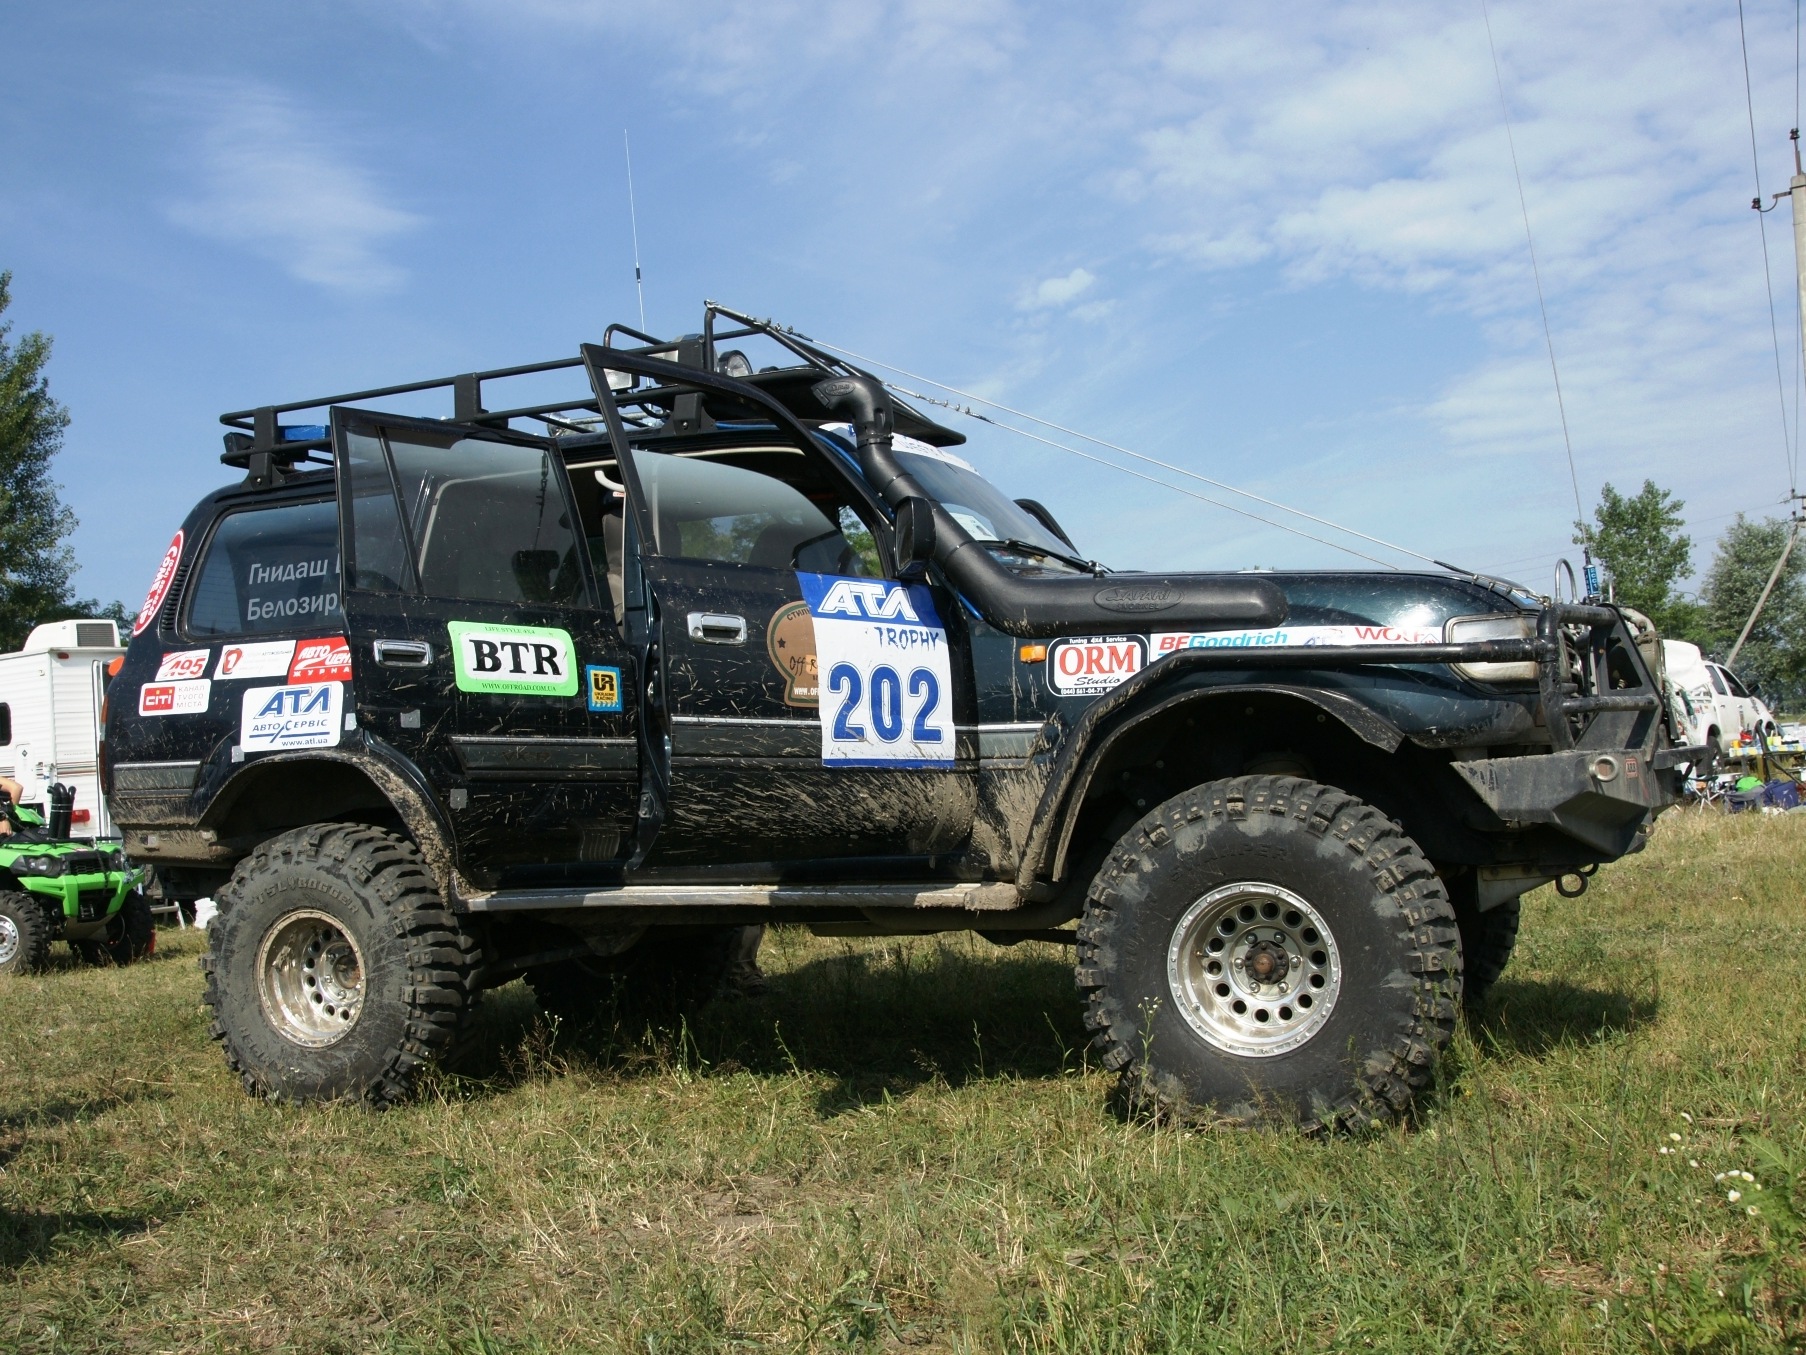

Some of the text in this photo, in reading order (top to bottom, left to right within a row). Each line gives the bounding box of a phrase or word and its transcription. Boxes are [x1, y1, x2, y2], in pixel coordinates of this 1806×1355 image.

[248, 559, 328, 585] Гнидаш
[247, 592, 342, 621] Белозир
[873, 626, 940, 651] TROPHY
[1159, 630, 1289, 651] BFGoodrich
[469, 639, 563, 676] BTR
[1059, 644, 1136, 676] ORM
[1074, 676, 1121, 686] Studio
[827, 661, 944, 744] 202
[281, 737, 328, 746] www.atl.ua
